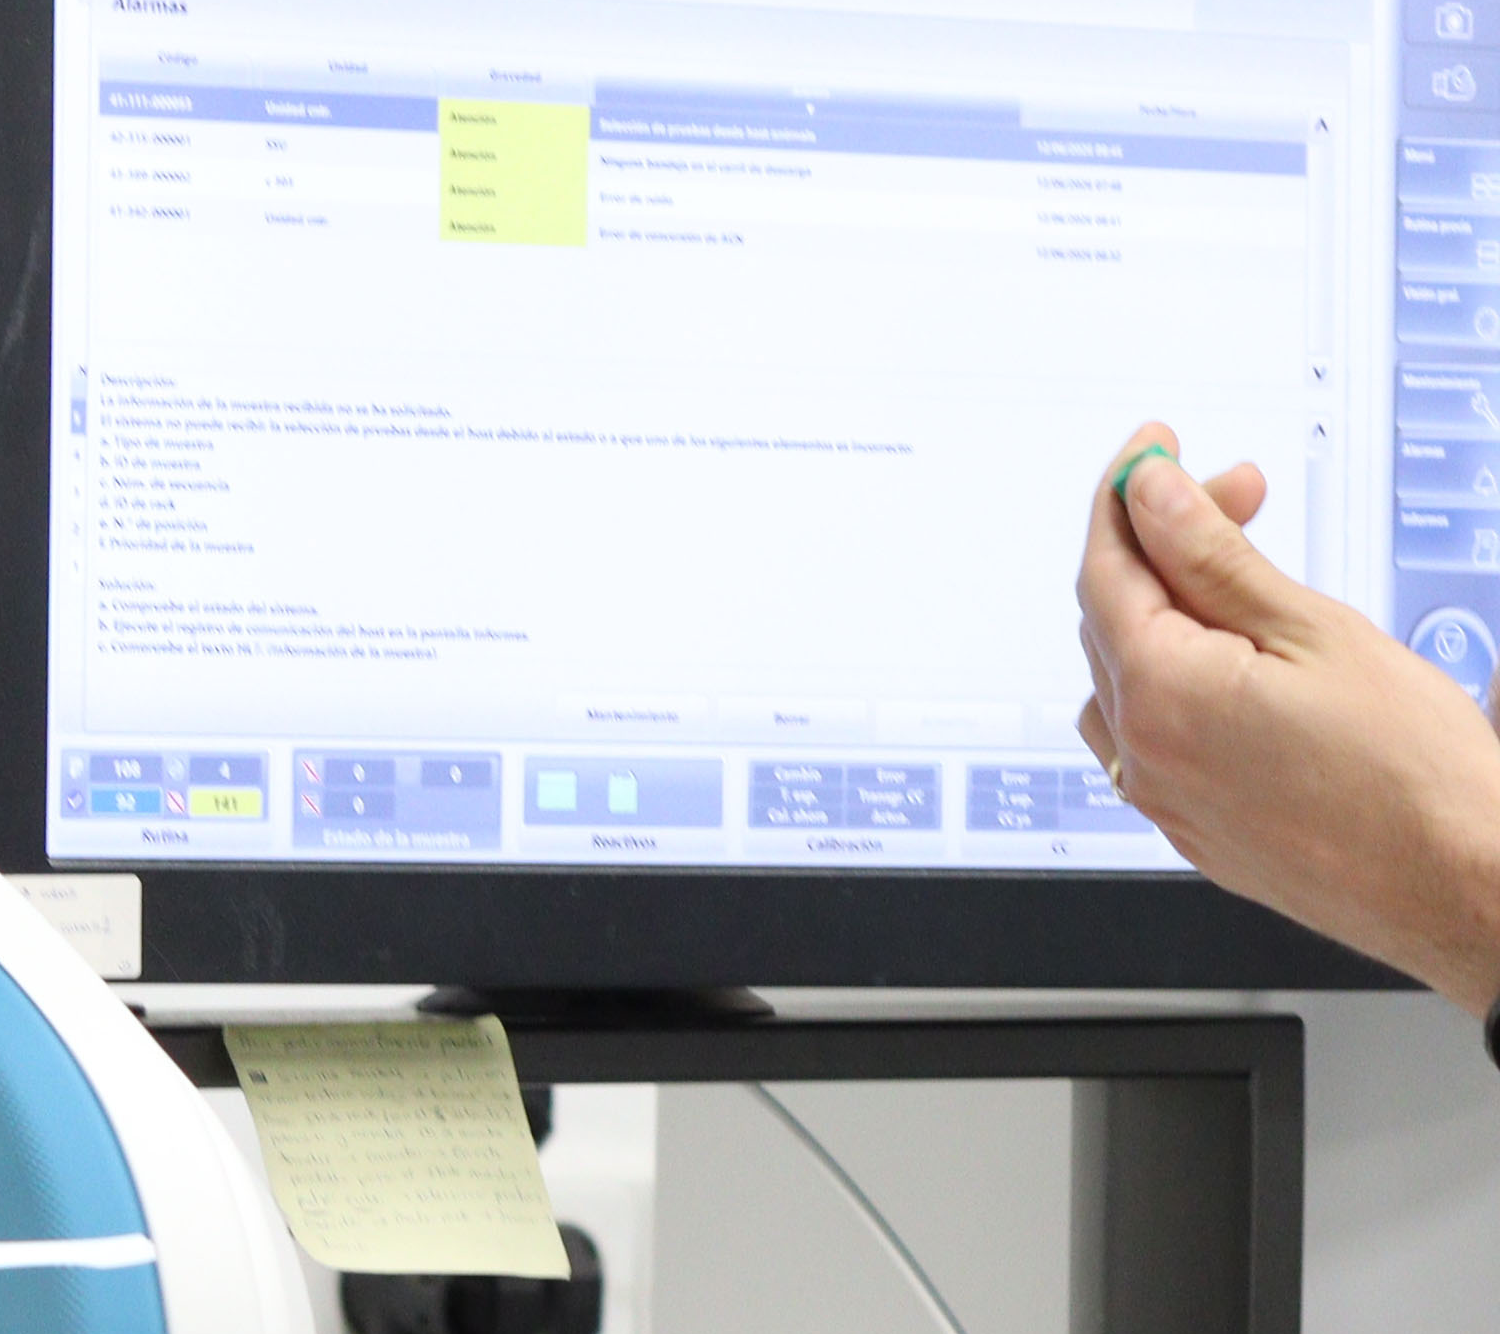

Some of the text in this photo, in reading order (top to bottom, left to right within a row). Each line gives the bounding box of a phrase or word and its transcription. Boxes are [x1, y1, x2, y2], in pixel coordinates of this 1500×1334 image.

[1402, 442, 1446, 458] Alarmas
[213, 794, 239, 813] 141
[323, 827, 373, 848] Estado
[413, 831, 471, 850] muestra
[806, 835, 883, 854] Calibración
